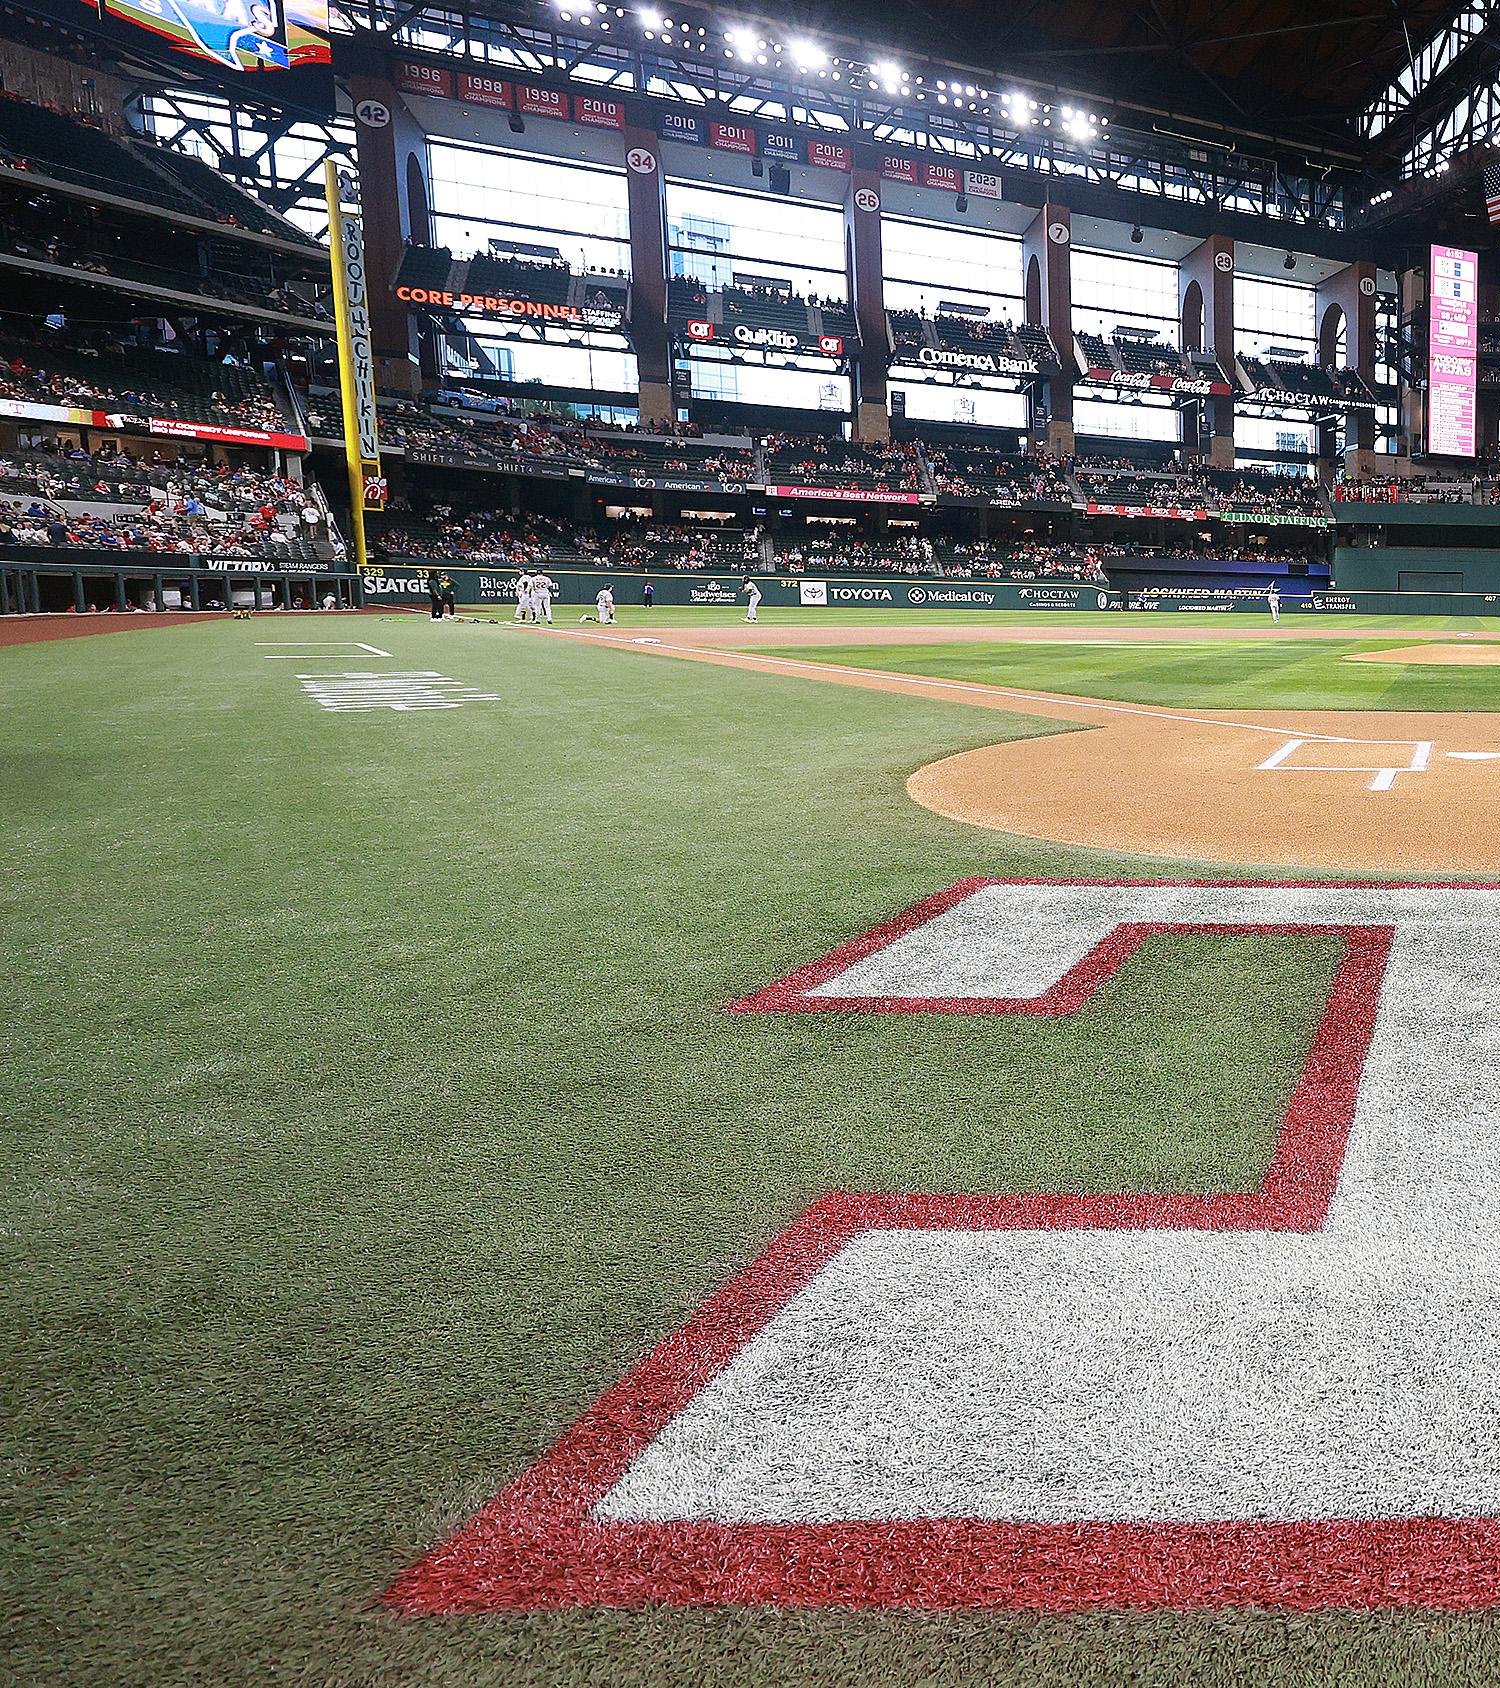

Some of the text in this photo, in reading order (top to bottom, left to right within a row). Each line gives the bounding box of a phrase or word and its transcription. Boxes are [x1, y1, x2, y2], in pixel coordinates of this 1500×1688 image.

[404, 64, 441, 82] 1996
[467, 77, 502, 93] 1998
[525, 88, 559, 104] 1999
[583, 99, 616, 115] 2010
[360, 107, 385, 122] 42
[665, 115, 696, 130] 2010
[719, 125, 746, 139] 2011
[768, 134, 794, 149] 2011
[816, 144, 843, 158] 2012
[631, 154, 651, 169] 34
[884, 157, 911, 171] 2015
[929, 165, 955, 179] 2016
[969, 173, 996, 187] 2023
[858, 194, 876, 207] 26
[1055, 228, 1063, 239] 7
[1217, 256, 1231, 268] 29
[1363, 281, 1372, 292] 10
[396, 287, 582, 320] CORE PERSONNEL
[581, 307, 622, 319] STAFFING
[734, 325, 799, 348] QuikTrip
[998, 356, 1039, 374] Bank
[355, 342, 375, 453] CHIKIN
[1260, 388, 1329, 406] CHOCTAW
[412, 452, 444, 463] SHIFT
[496, 462, 525, 472] SHIFT
[588, 475, 617, 484] American
[664, 481, 700, 490] American
[790, 487, 908, 501] America's Best Network
[990, 499, 1021, 507] ARENA
[1097, 504, 1118, 512] DEX
[1151, 507, 1170, 515] DEX
[1232, 513, 1326, 526] LUXOR STAFFING
[363, 568, 384, 577] 329
[363, 577, 430, 594] SEATGE
[781, 580, 797, 588] 372
[831, 588, 892, 600] TOYOTA
[927, 591, 995, 604] Medical City
[1019, 588, 1080, 599] CHOCTAW
[1142, 587, 1265, 600] LOCKHEED MARTIN
